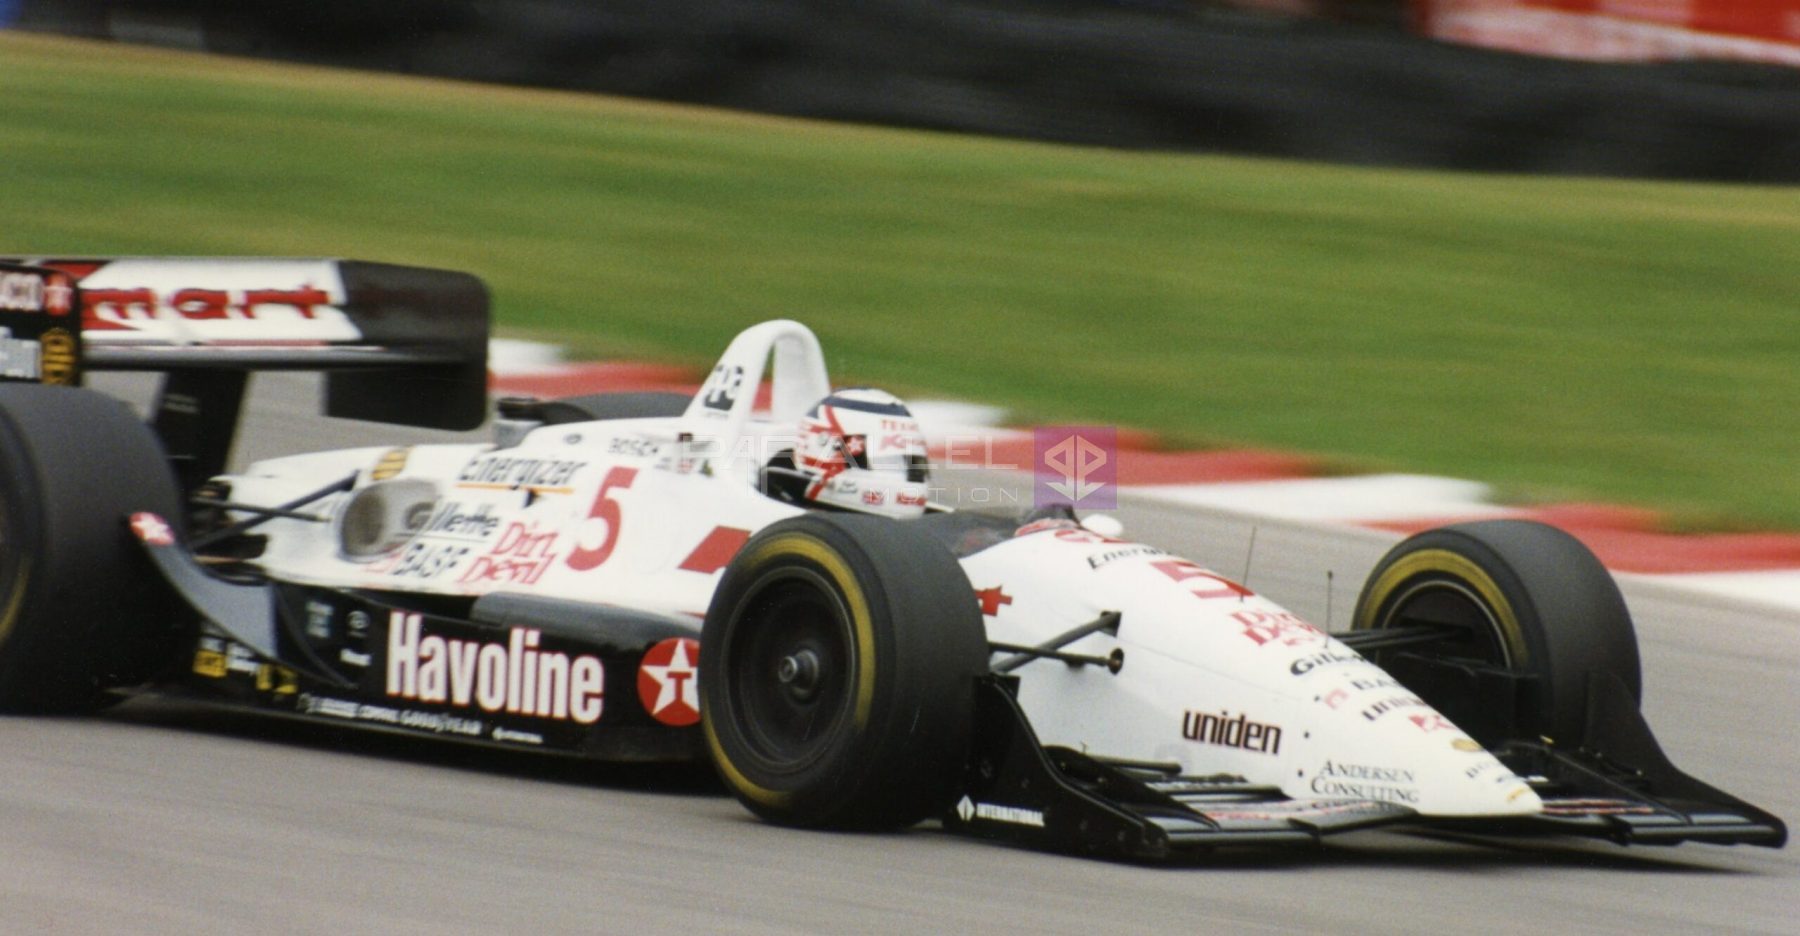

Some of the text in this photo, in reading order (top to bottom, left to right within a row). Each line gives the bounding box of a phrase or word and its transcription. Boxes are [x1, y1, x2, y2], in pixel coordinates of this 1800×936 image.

[78, 281, 330, 330] mart
[457, 456, 588, 490] Energizer
[565, 466, 640, 572] 5
[1150, 560, 1256, 600] 5
[386, 610, 605, 724] Havoline
[1182, 709, 1282, 755] uniden
